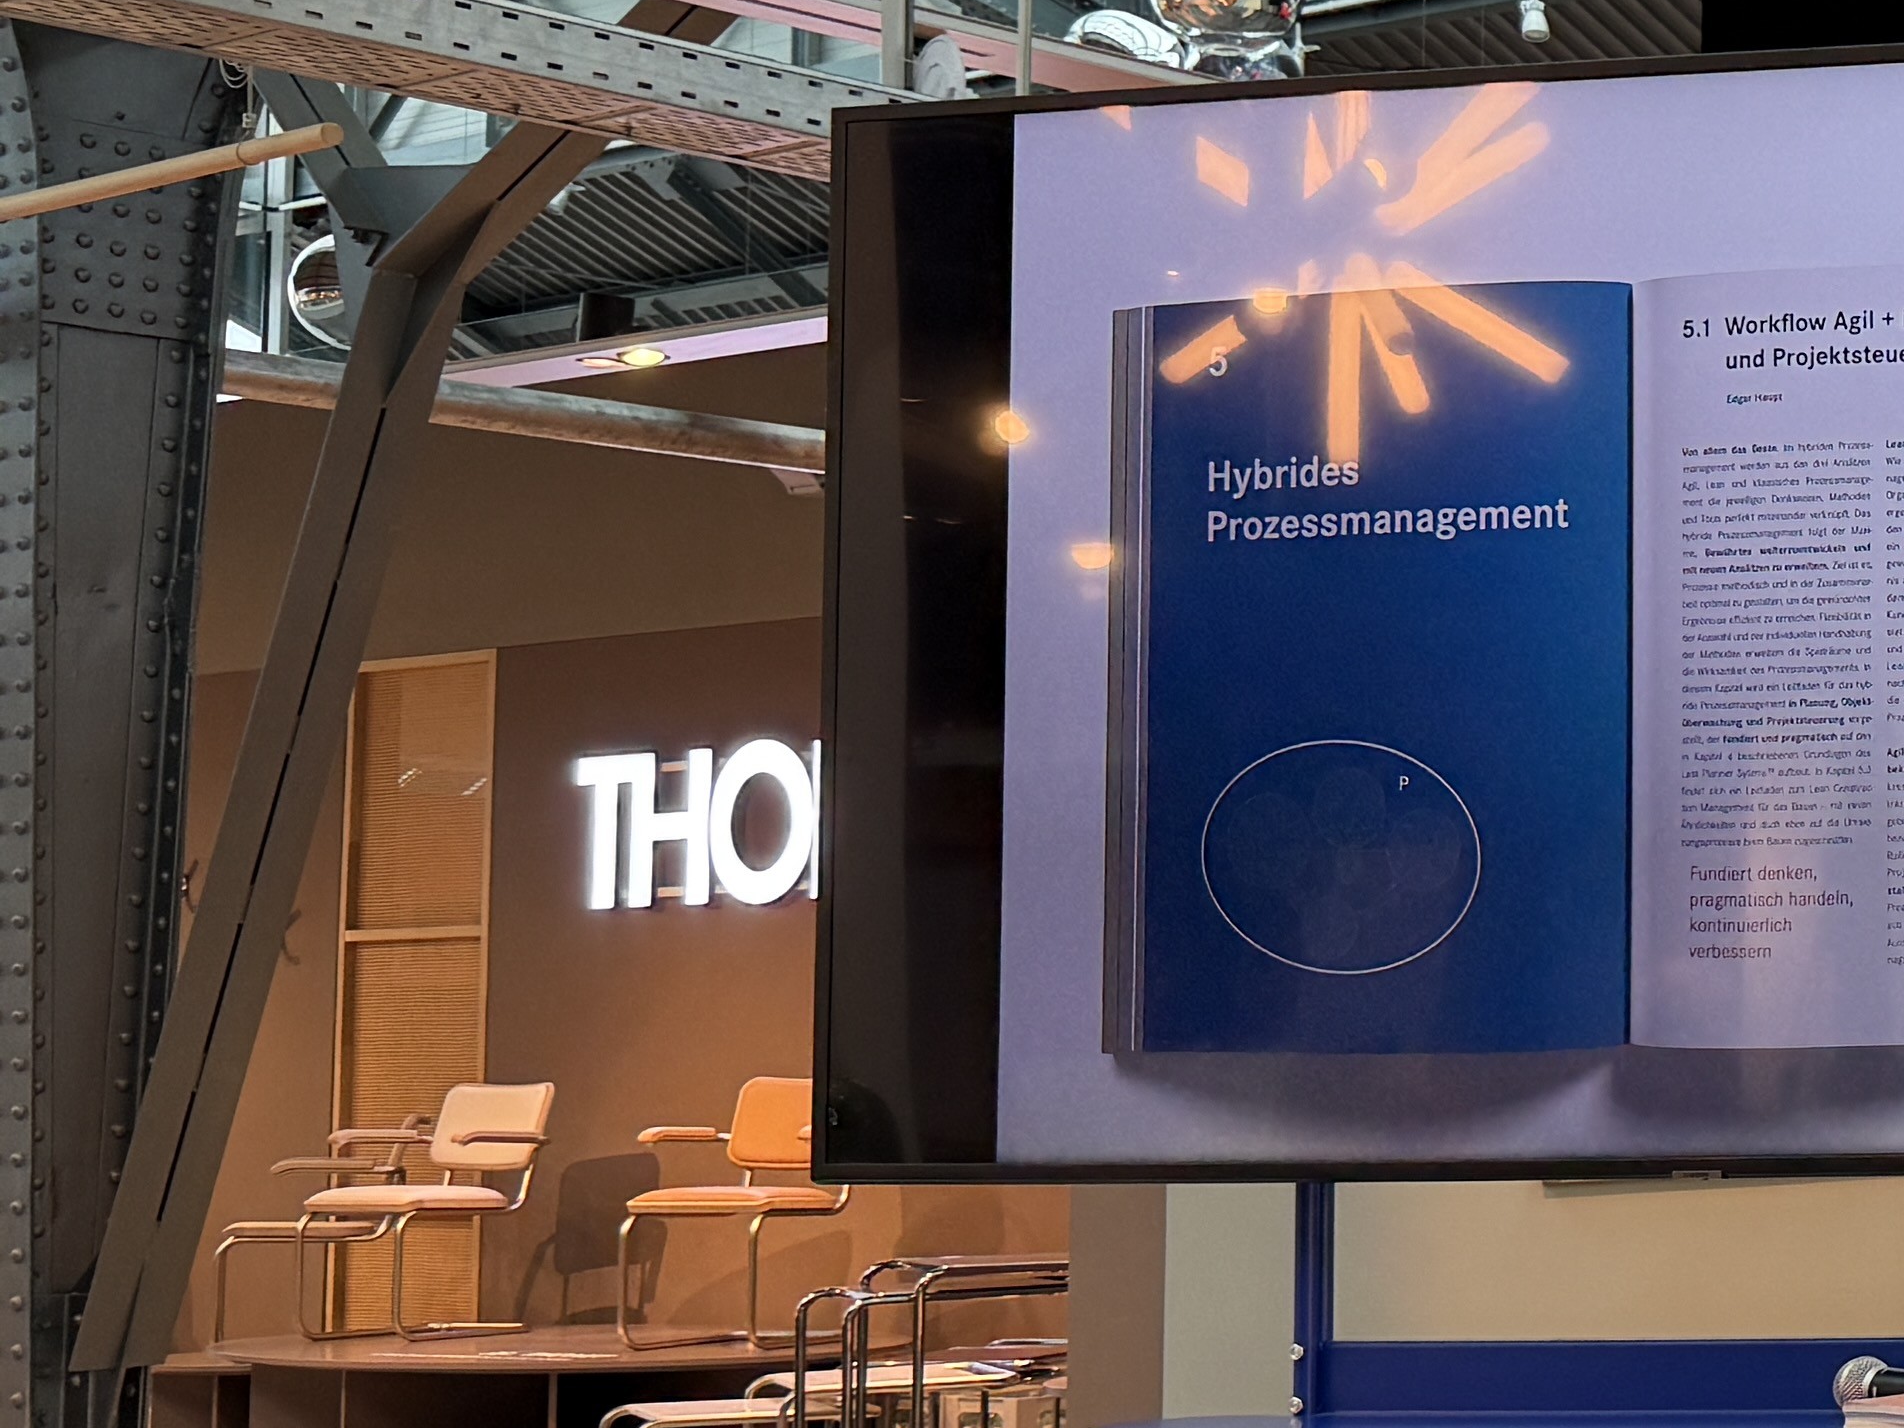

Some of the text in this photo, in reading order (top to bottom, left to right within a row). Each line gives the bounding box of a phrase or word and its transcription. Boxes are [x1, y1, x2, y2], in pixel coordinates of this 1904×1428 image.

[1682, 318, 1710, 339] 5.1
[1725, 313, 1827, 337] Workflow
[1833, 309, 1876, 335] Agil
[1881, 312, 1895, 326] +
[1209, 346, 1228, 377] 5
[1726, 349, 1765, 370] und
[1207, 456, 1360, 494] Hybrides
[1207, 498, 1569, 542] Prozessmanagement
[1399, 775, 1409, 791] P
[577, 738, 821, 910] THO
[1690, 865, 1817, 881] Fundiert denken,
[1690, 890, 1853, 911] pragmatisch handeln,
[1690, 917, 1792, 933] kontinuierlich
[1689, 944, 1772, 958] verbessern
